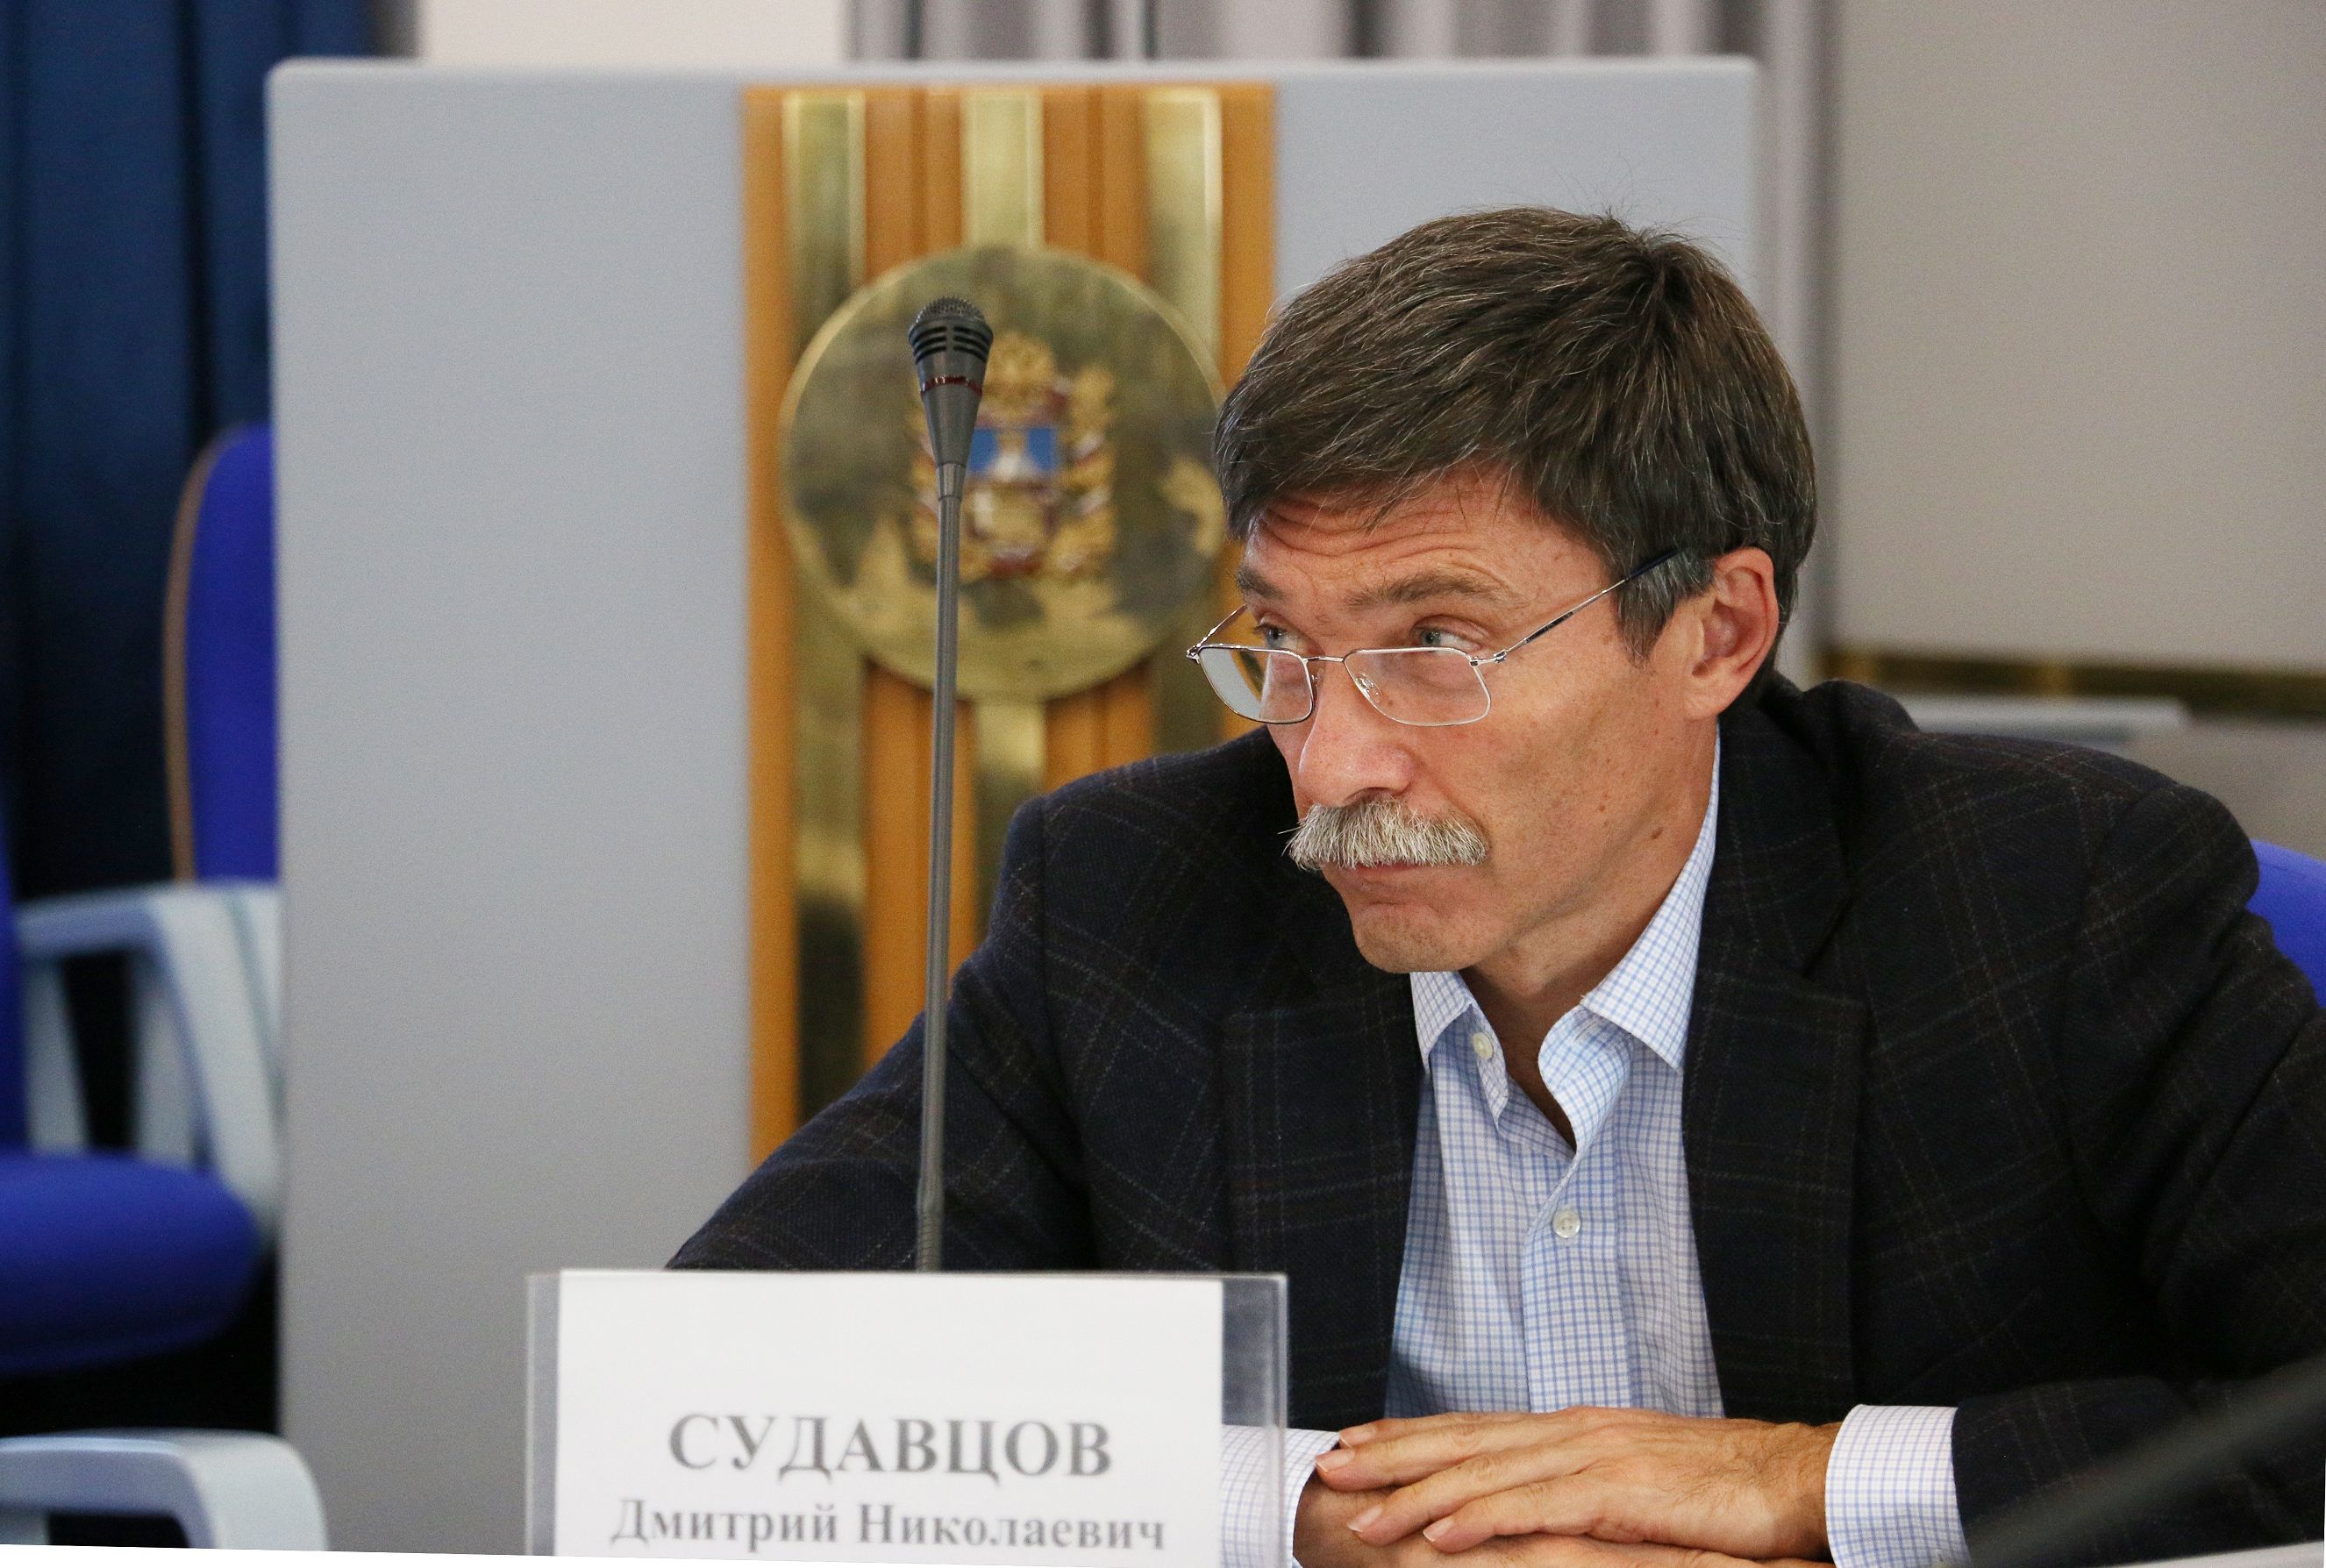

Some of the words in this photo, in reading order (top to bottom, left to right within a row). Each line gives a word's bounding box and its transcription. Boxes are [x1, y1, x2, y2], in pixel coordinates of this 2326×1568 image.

[667, 1412, 1113, 1486] СУДАВЦОВ
[611, 1498, 839, 1554] Дмитрий
[859, 1503, 1166, 1551] Николаевич
